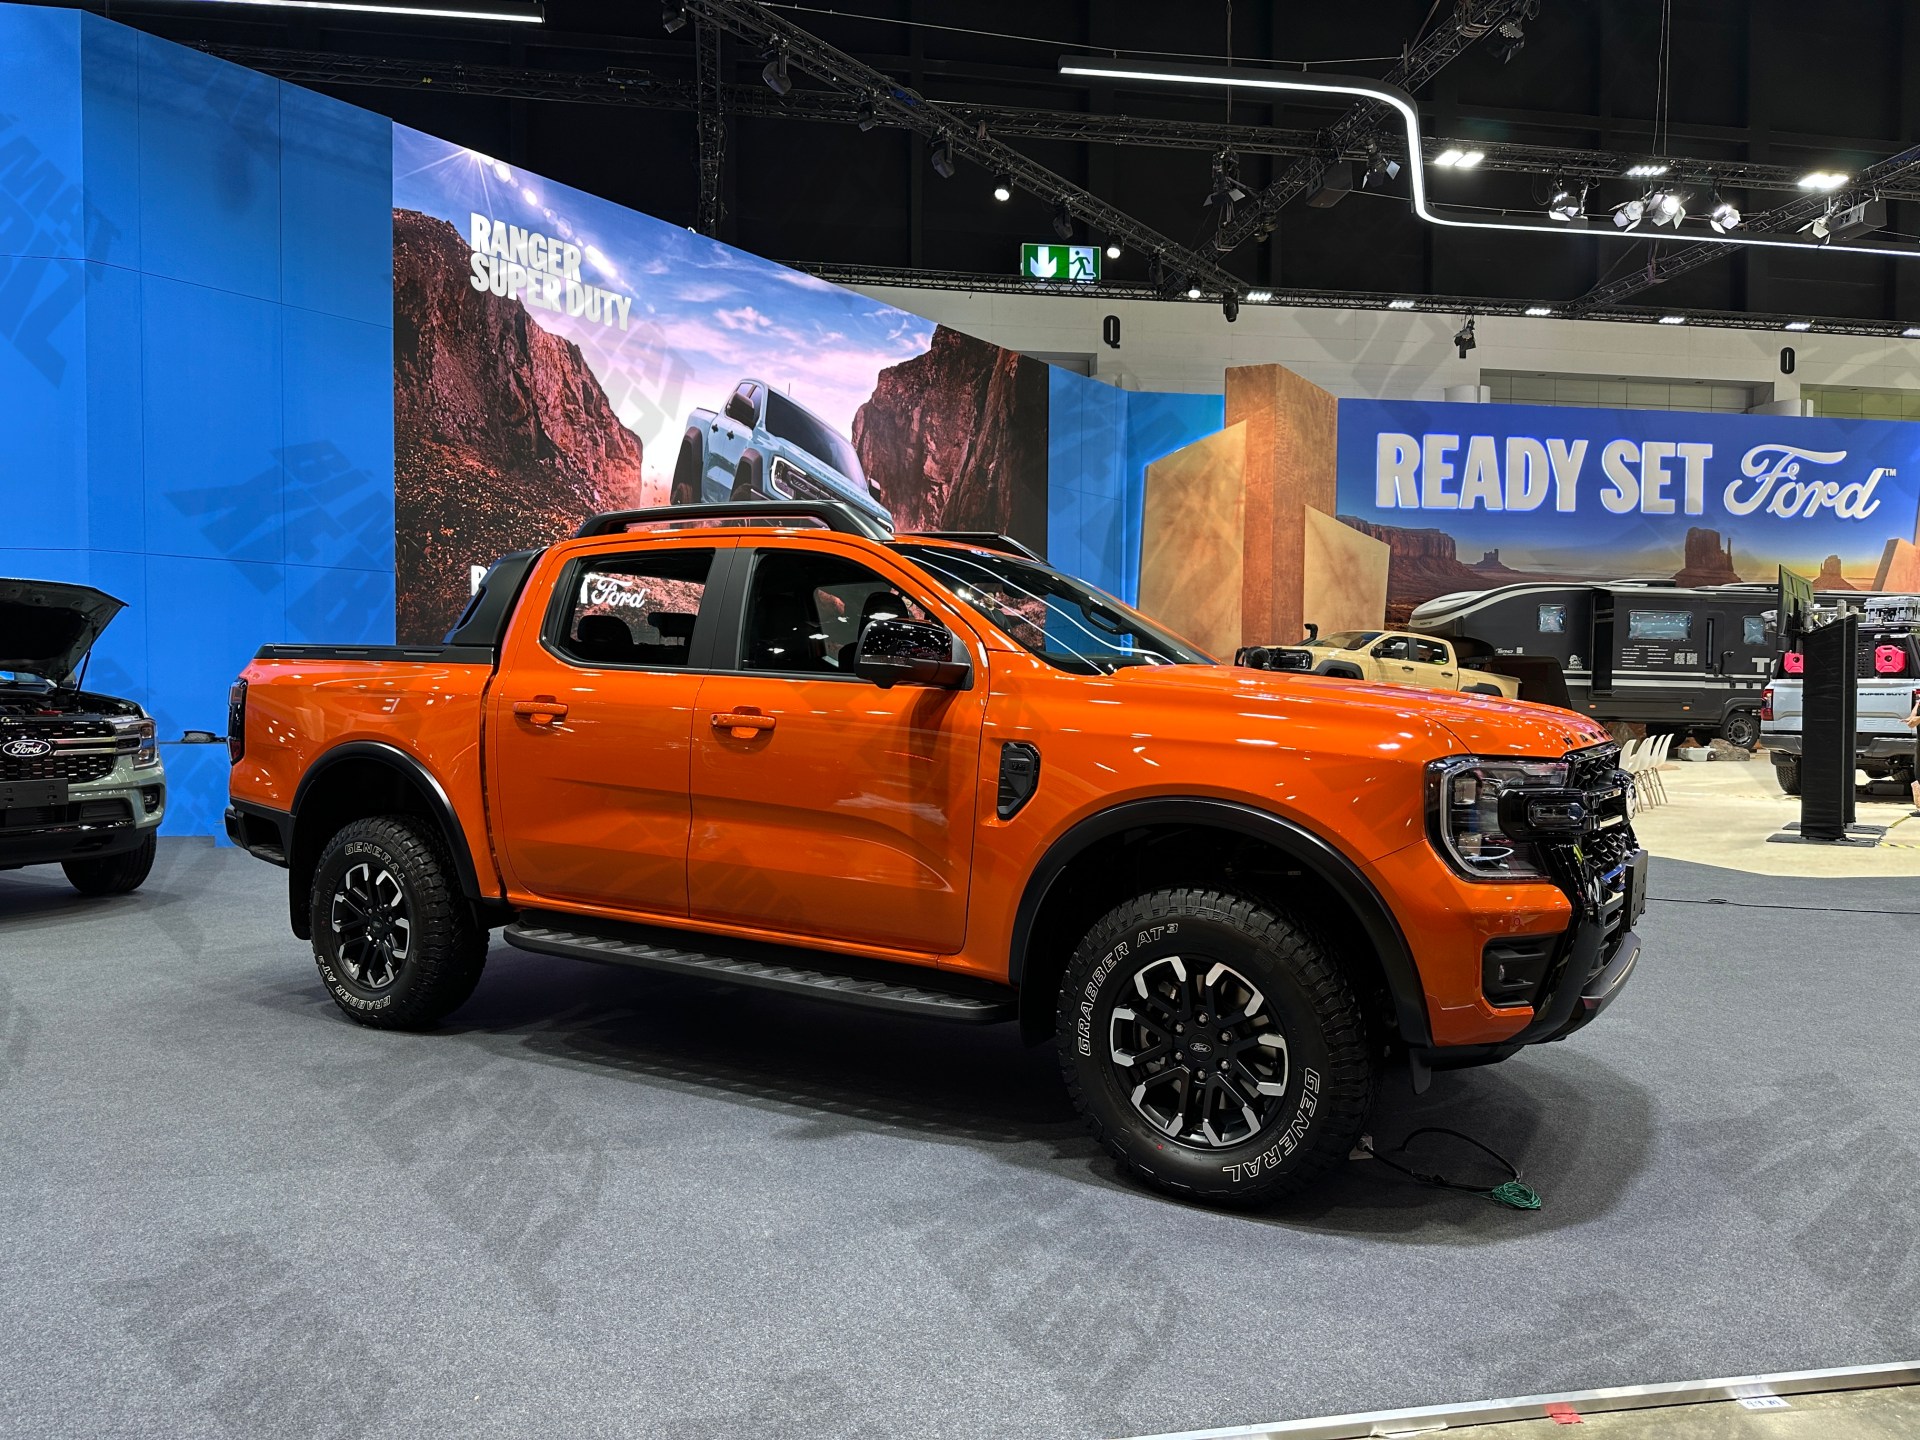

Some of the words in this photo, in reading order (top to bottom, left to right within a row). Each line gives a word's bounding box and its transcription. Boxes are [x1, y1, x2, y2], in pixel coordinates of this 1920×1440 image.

[471, 212, 582, 283] RANGER
[470, 252, 562, 313] SUPER
[566, 278, 632, 332] DUTY
[1103, 315, 1120, 349] Q
[1376, 432, 1589, 513] READY
[1600, 438, 1713, 515] SET
[1723, 443, 1885, 520] Ford
[591, 574, 648, 609] Ford
[11, 741, 42, 755] Ford
[344, 841, 406, 887] GENERAL
[1077, 941, 1130, 1057] GRABBER
[1222, 1067, 1320, 1182] GENERAL
